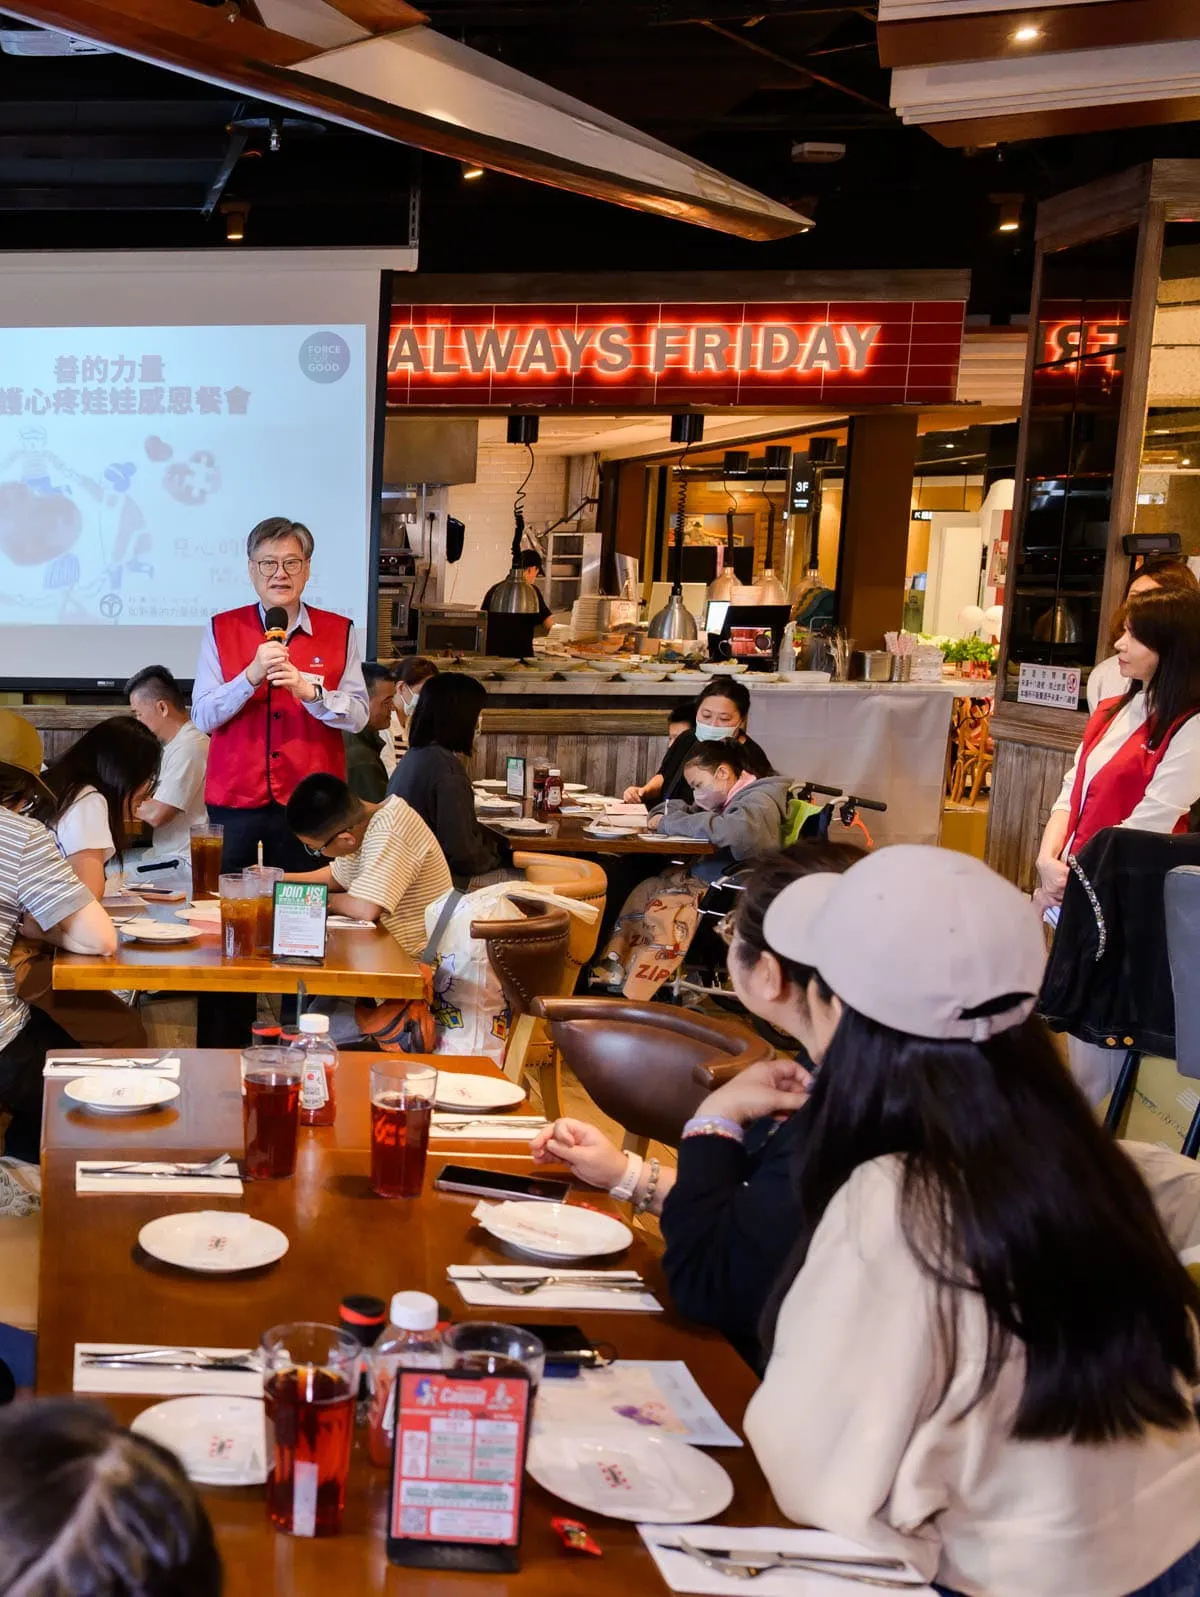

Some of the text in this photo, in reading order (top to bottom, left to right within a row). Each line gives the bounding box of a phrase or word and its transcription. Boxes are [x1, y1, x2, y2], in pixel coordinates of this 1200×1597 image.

[308, 345, 341, 354] FORCE
[388, 325, 882, 373] ALWAYS FRIDAY
[53, 355, 165, 384] 善的力量
[308, 363, 340, 372] GOOD
[795, 481, 809, 493] 3F
[279, 885, 324, 899] JOIN US!
[635, 964, 670, 981] ZIP
